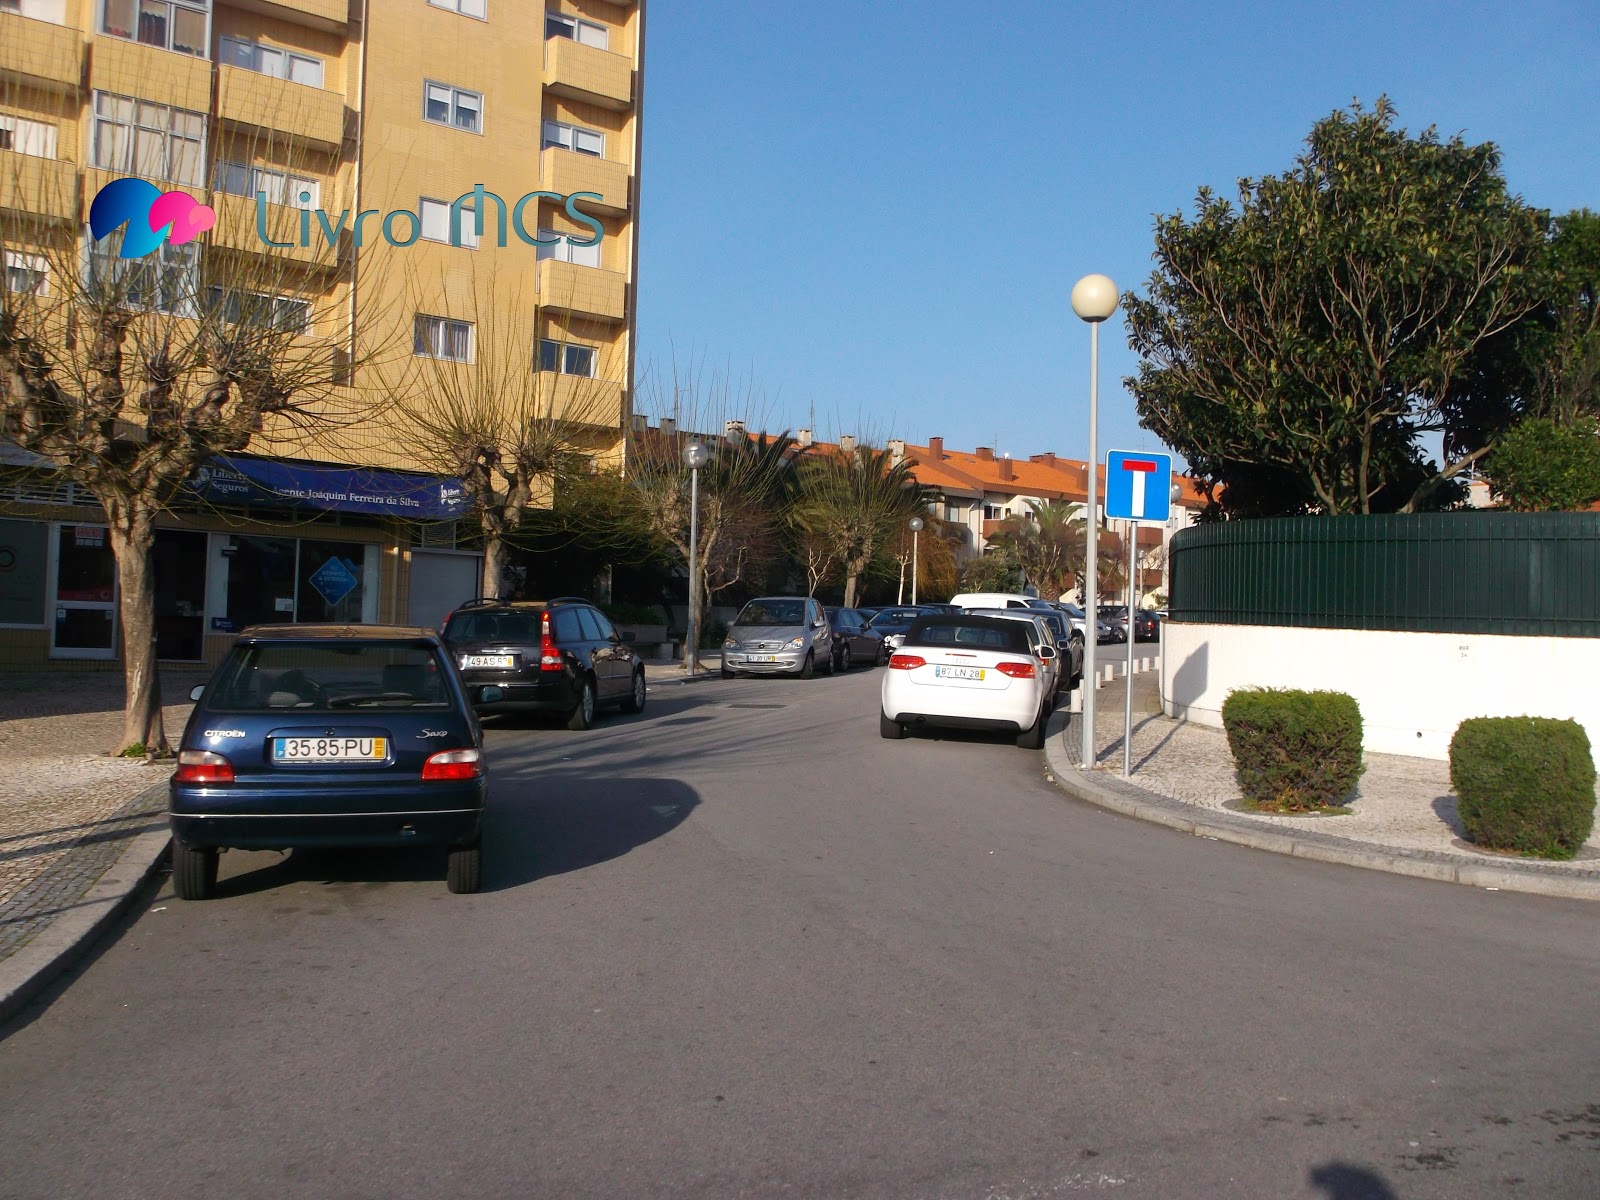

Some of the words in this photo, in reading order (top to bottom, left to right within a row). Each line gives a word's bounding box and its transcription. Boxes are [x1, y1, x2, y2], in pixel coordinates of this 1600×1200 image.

[211, 481, 249, 493] Seguros
[307, 488, 347, 502] Joaquim
[349, 492, 384, 504] Ferreira
[386, 496, 397, 505] da
[399, 497, 420, 507] Silva
[415, 728, 448, 739] Saxo
